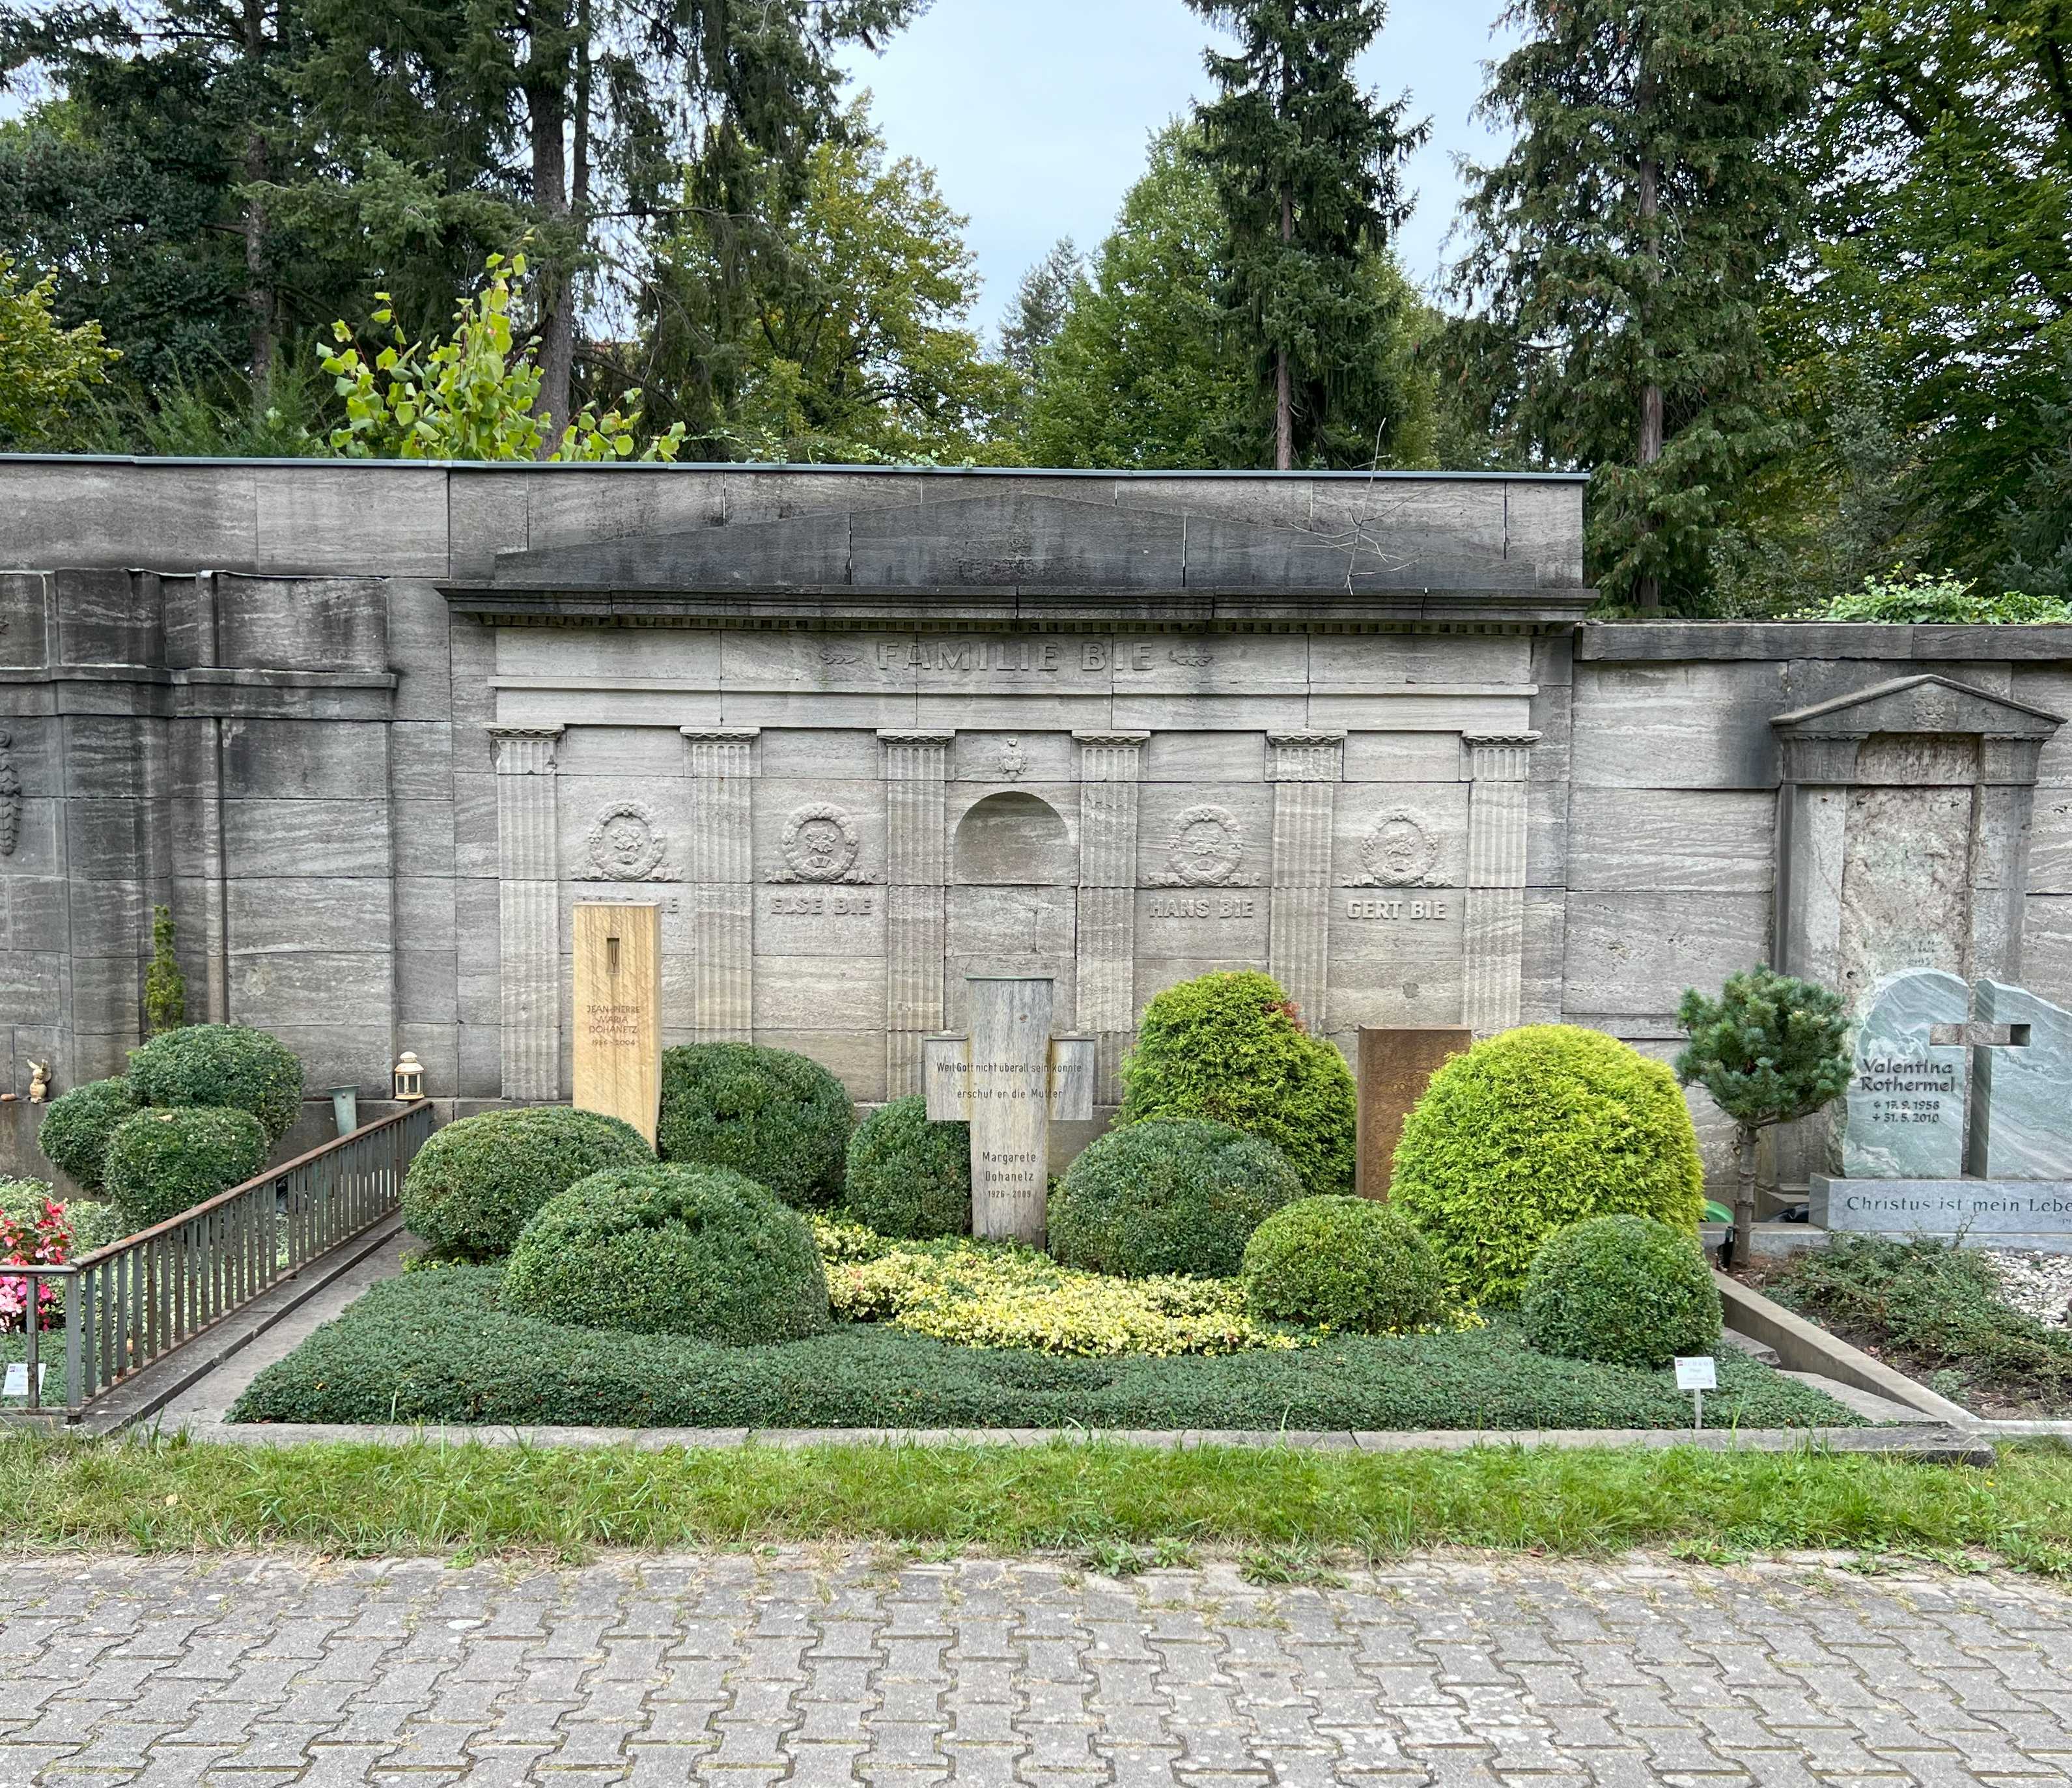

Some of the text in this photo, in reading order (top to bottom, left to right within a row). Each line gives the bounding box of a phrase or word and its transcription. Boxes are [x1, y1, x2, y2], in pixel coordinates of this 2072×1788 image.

[878, 641, 1155, 671] FAMILIE BIE
[770, 897, 871, 915] ELSE BIE
[1149, 899, 1253, 918] HANS BIE
[1347, 900, 1446, 919] GERT BIE
[594, 1015, 628, 1024] MARIA
[589, 1026, 638, 1034] DOHANETZ
[936, 1062, 955, 1073] Weil
[957, 1062, 973, 1072] Gott
[975, 1062, 997, 1072] nicht
[1031, 1063, 1048, 1072] sein
[1862, 1058, 1953, 1074] Valentina
[1859, 1076, 1955, 1092] Rothermel
[957, 1088, 1063, 1099] erschuf er die Mutter
[1884, 1113, 1898, 1123] 31.
[1901, 1113, 1910, 1123] 5.
[1912, 1113, 1939, 1124] 2010
[982, 1151, 1036, 1166] Margarete
[985, 1171, 1034, 1182] Dohanetz
[1846, 1196, 1931, 1210] Christus
[1939, 1197, 1963, 1210] ist
[1972, 1197, 2020, 1212] mein
